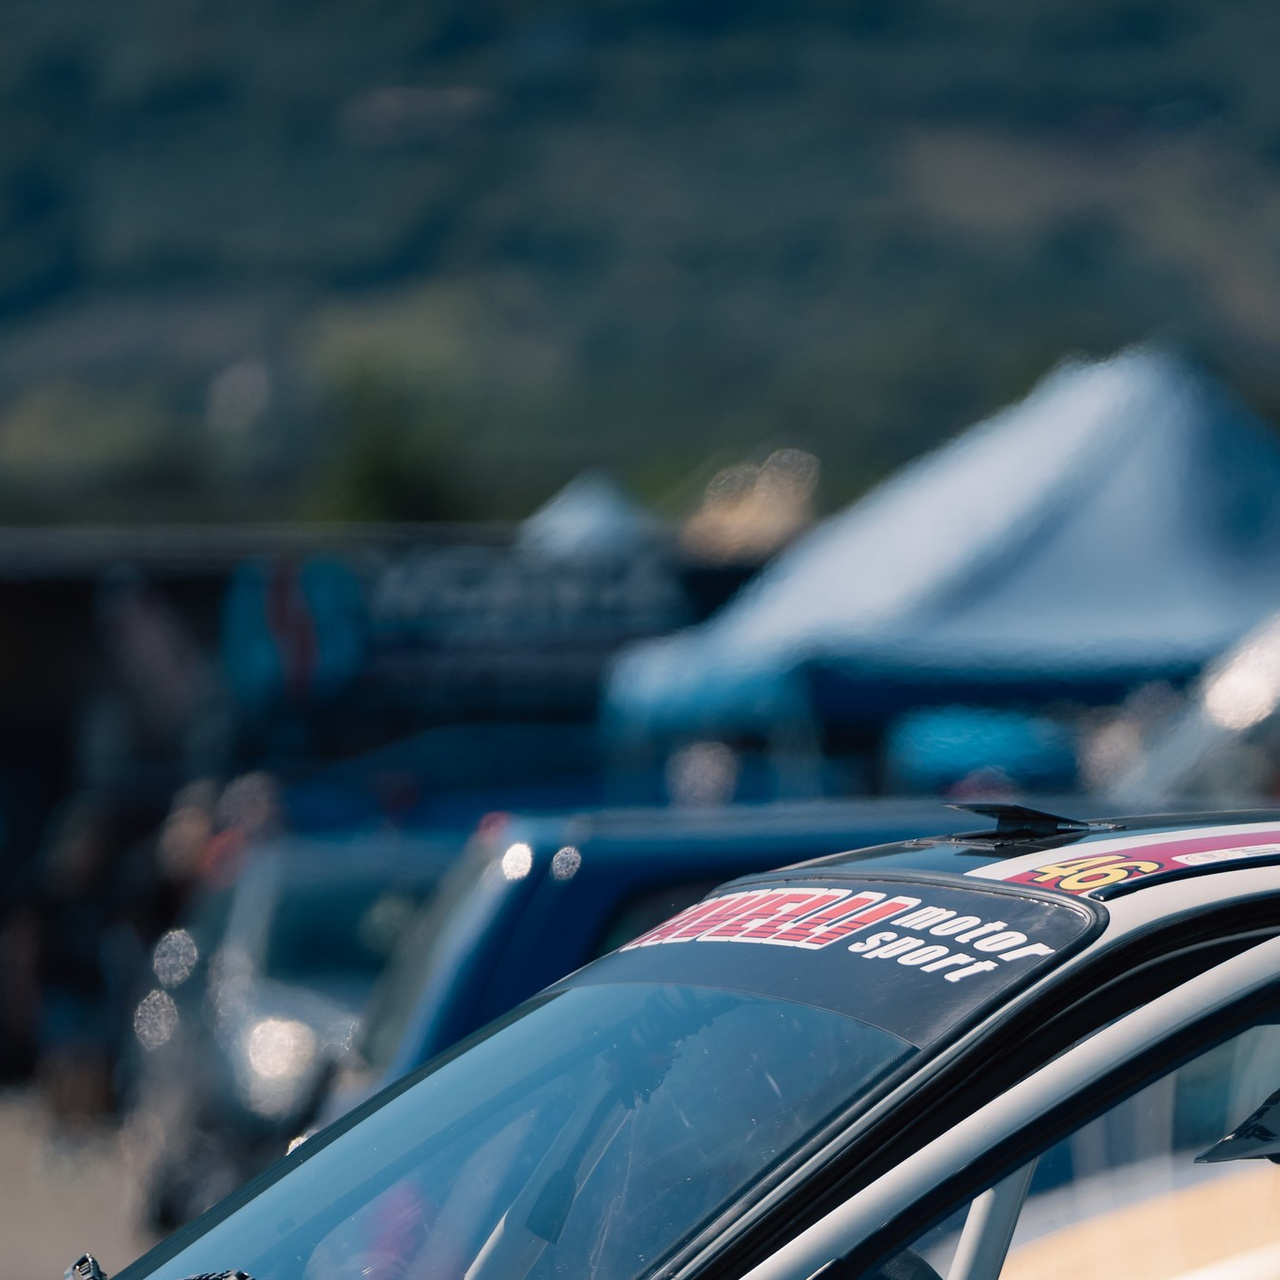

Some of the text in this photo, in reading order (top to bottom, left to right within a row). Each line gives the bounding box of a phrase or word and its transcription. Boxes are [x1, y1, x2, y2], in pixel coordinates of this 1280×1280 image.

[1029, 854, 1164, 892] 46
[848, 929, 998, 984] sport
[893, 906, 1055, 963] motor
